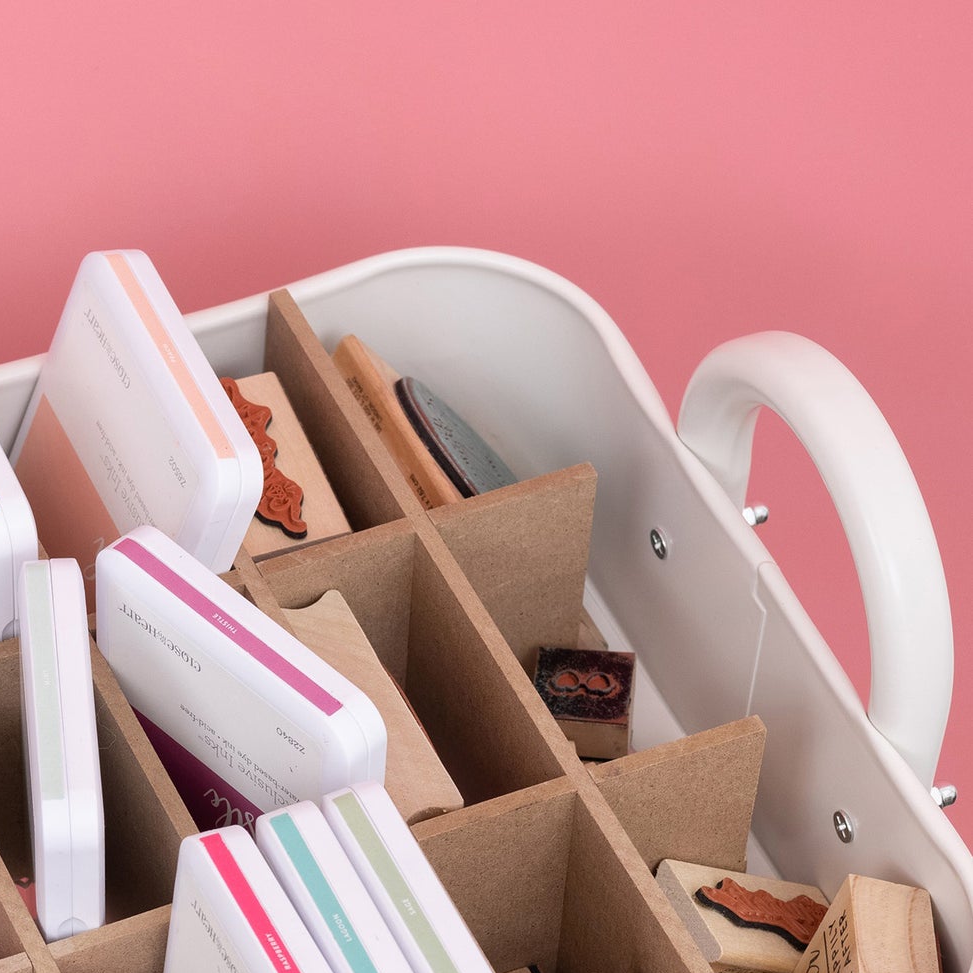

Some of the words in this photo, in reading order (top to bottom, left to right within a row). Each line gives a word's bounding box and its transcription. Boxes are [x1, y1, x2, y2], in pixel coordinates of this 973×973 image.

[211, 612, 237, 634] THISTLE
[179, 704, 217, 735] acid-free
[237, 747, 253, 764] dye
[276, 727, 306, 755] Z2840
[402, 898, 417, 916] SAGE
[332, 913, 353, 943] LAGOON
[839, 910, 852, 966] AFTER
[265, 933, 292, 970] RASPBERRY
